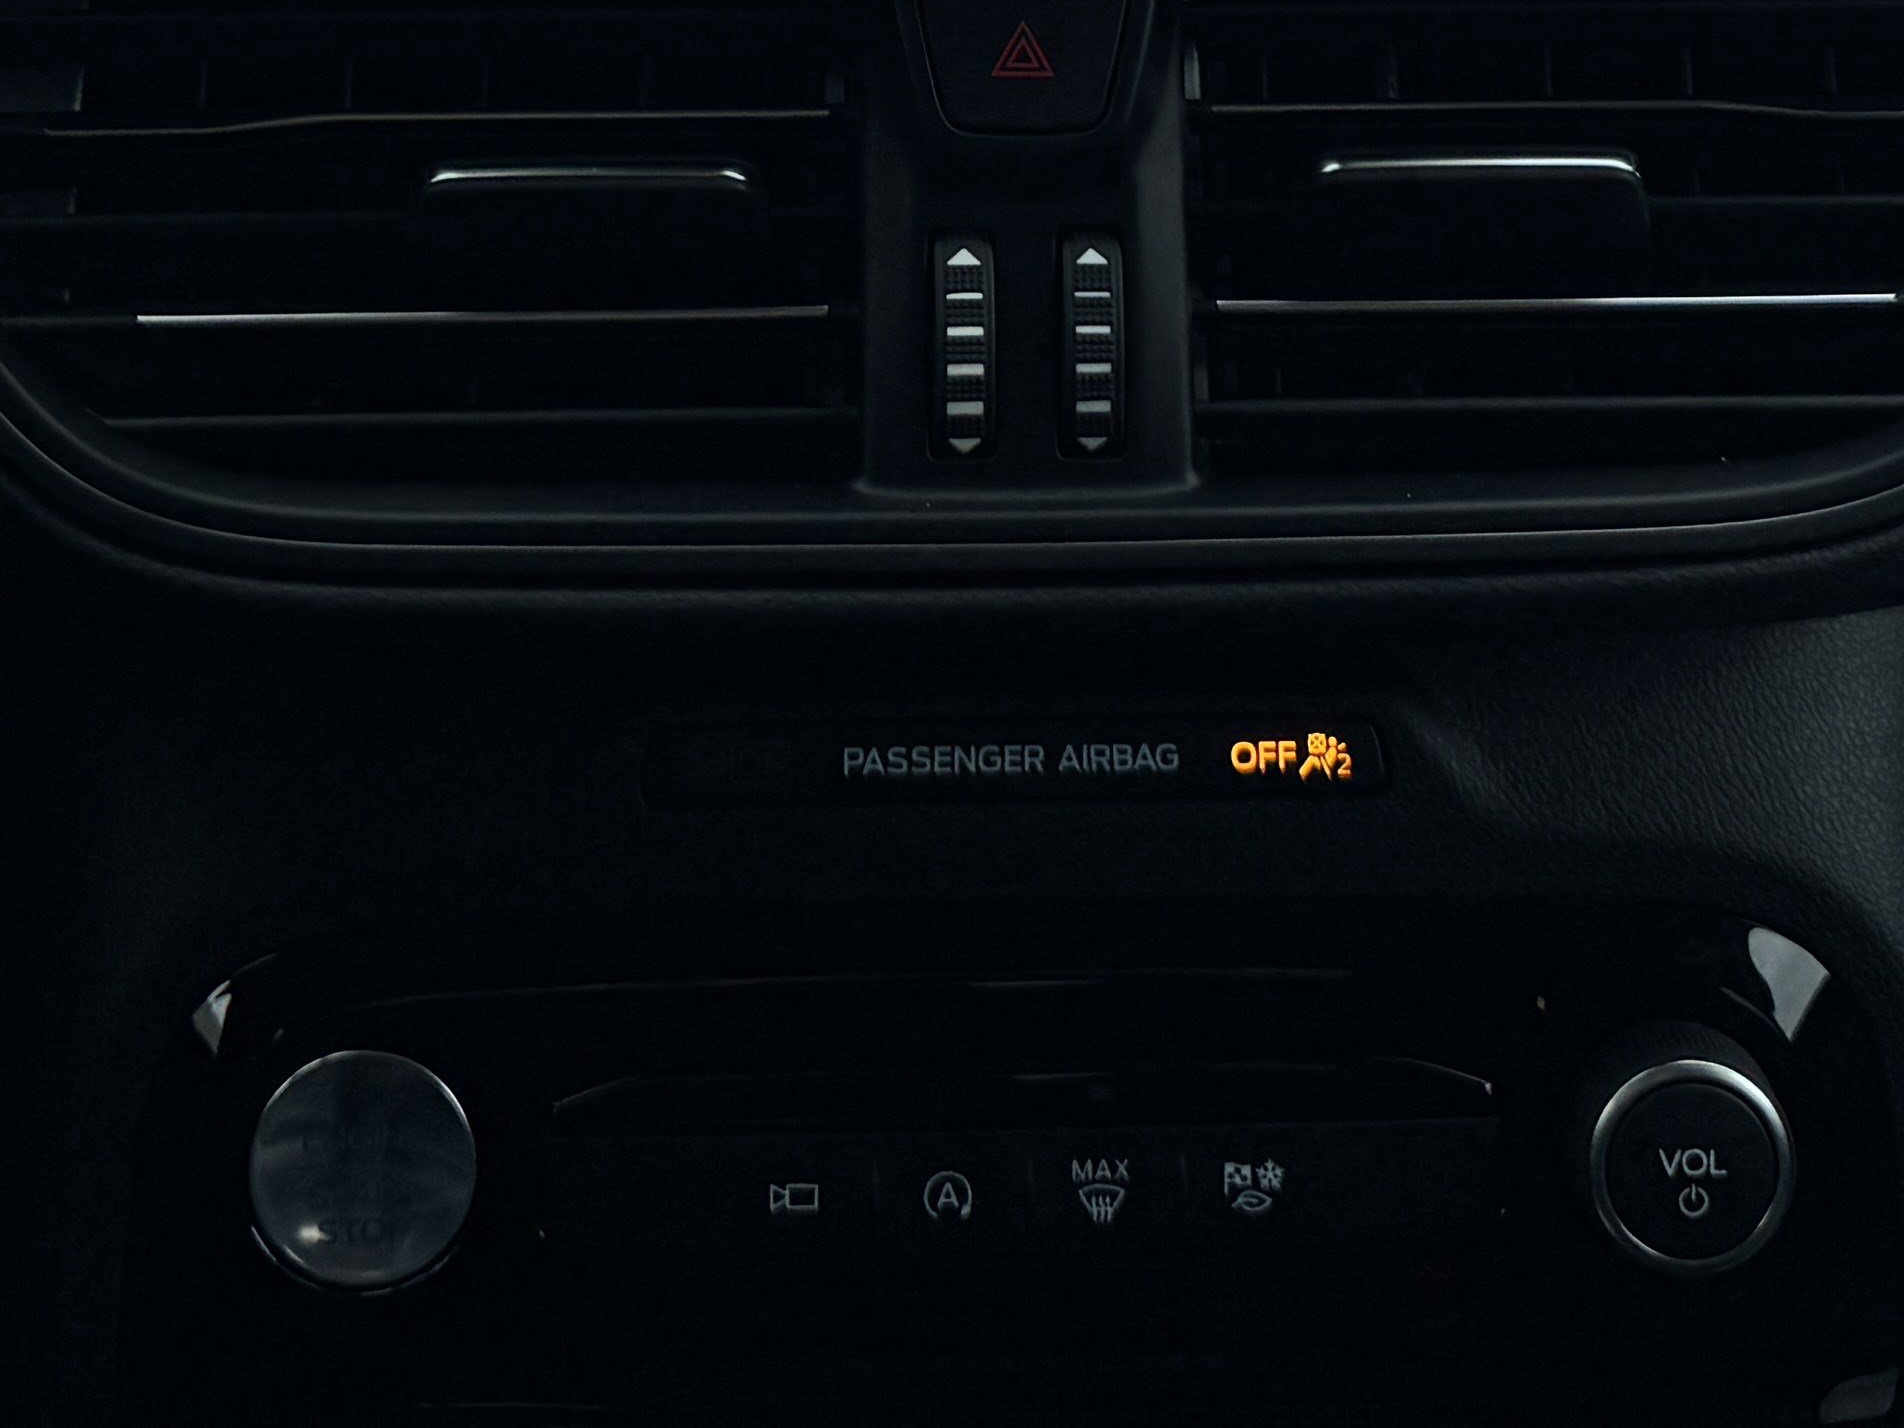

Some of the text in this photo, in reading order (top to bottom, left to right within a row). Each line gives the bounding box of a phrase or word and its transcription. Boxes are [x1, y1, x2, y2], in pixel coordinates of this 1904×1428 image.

[843, 745, 1046, 777] PASSENGER
[1058, 743, 1180, 773] AIRBAG
[1230, 740, 1297, 775] OFF
[1071, 1158, 1129, 1183] MAX
[1658, 1147, 1728, 1177] VOL
